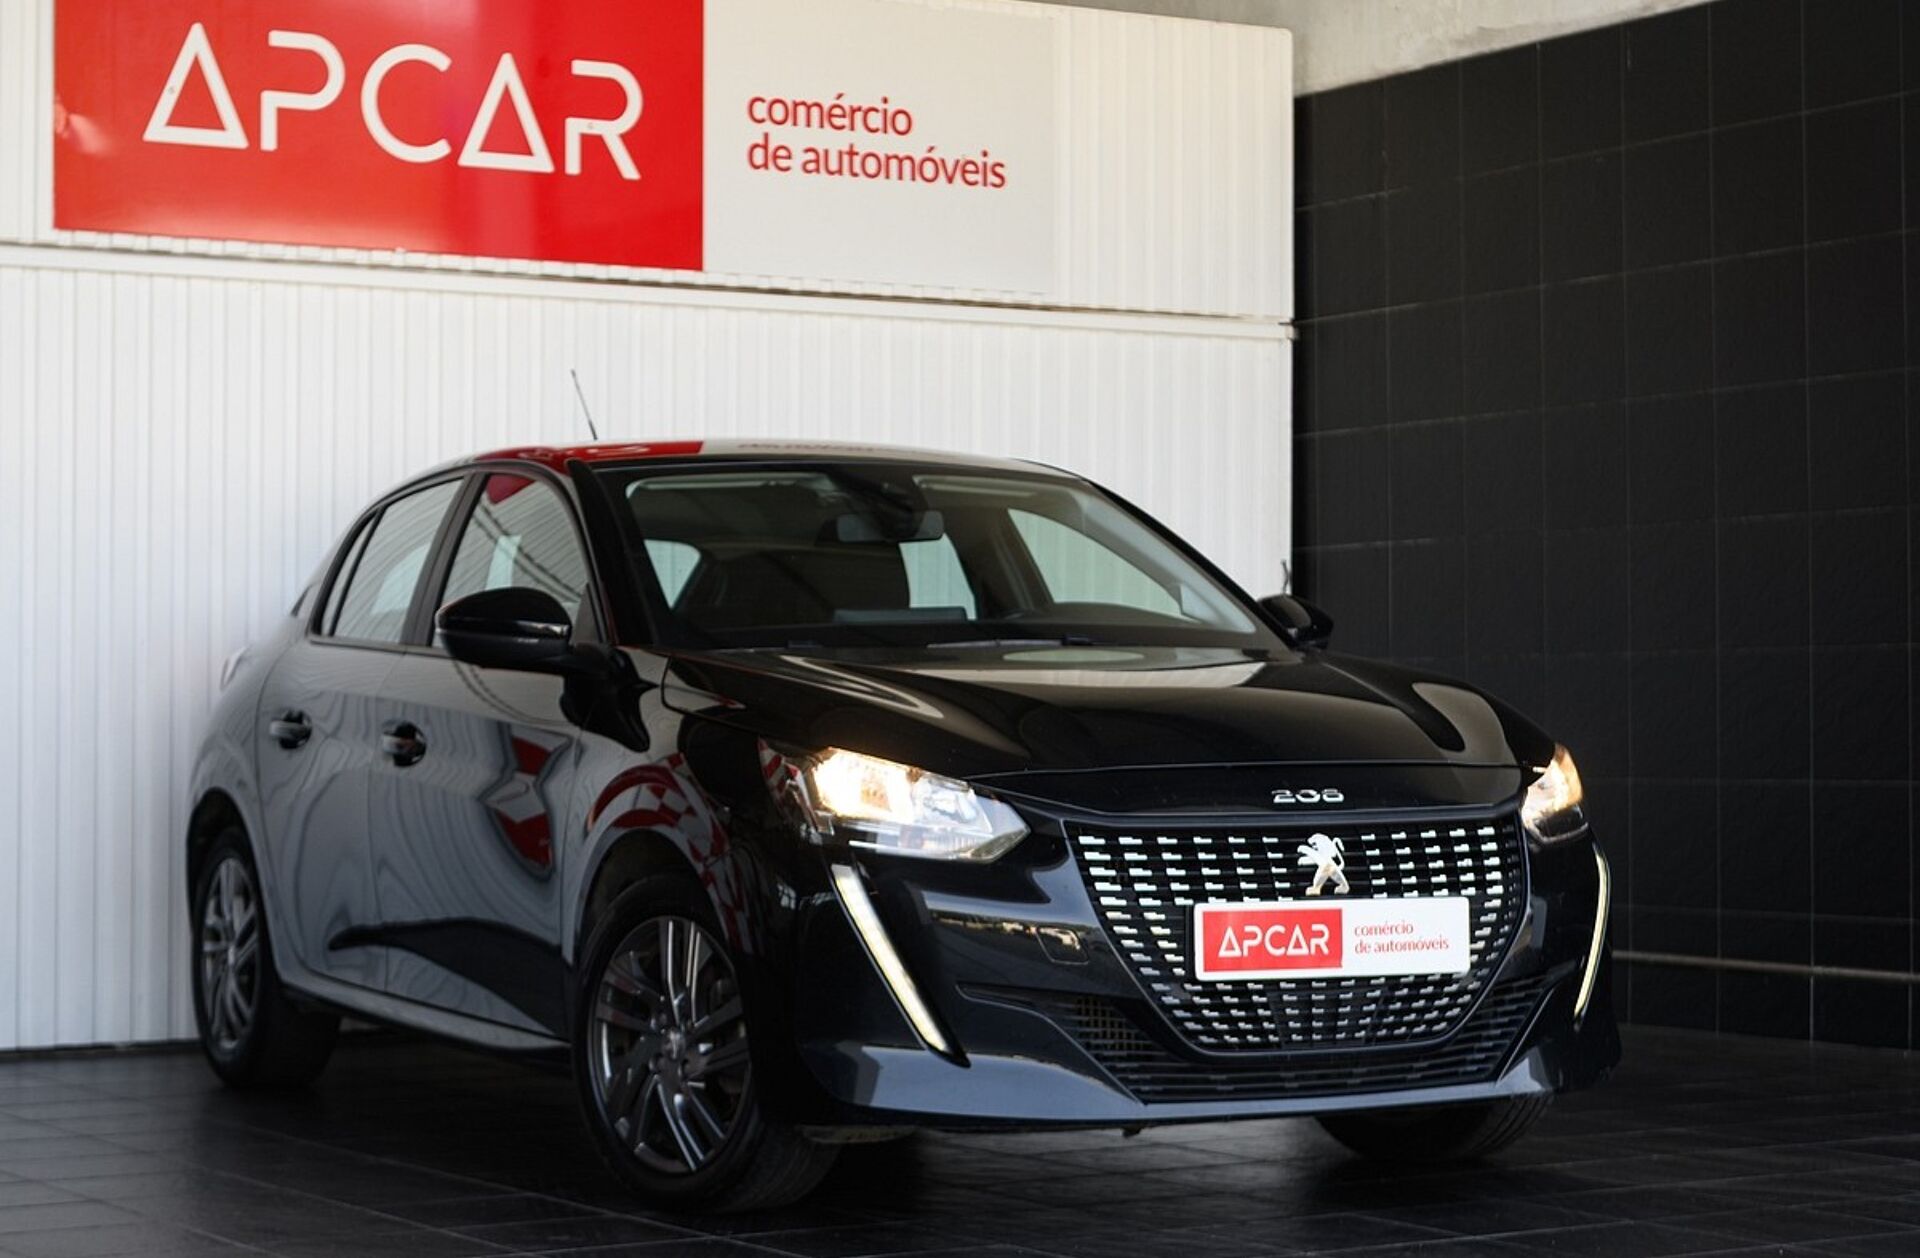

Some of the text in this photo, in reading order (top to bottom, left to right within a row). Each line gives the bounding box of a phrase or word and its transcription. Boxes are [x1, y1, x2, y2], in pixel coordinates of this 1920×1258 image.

[142, 21, 643, 180] APCAR
[748, 93, 913, 136] comércio
[748, 133, 1006, 189] de automóveis
[1271, 789, 1344, 804] 208
[1218, 924, 1330, 957] APCAR
[1354, 921, 1414, 936] comércio
[1354, 936, 1449, 954] de automóveis
